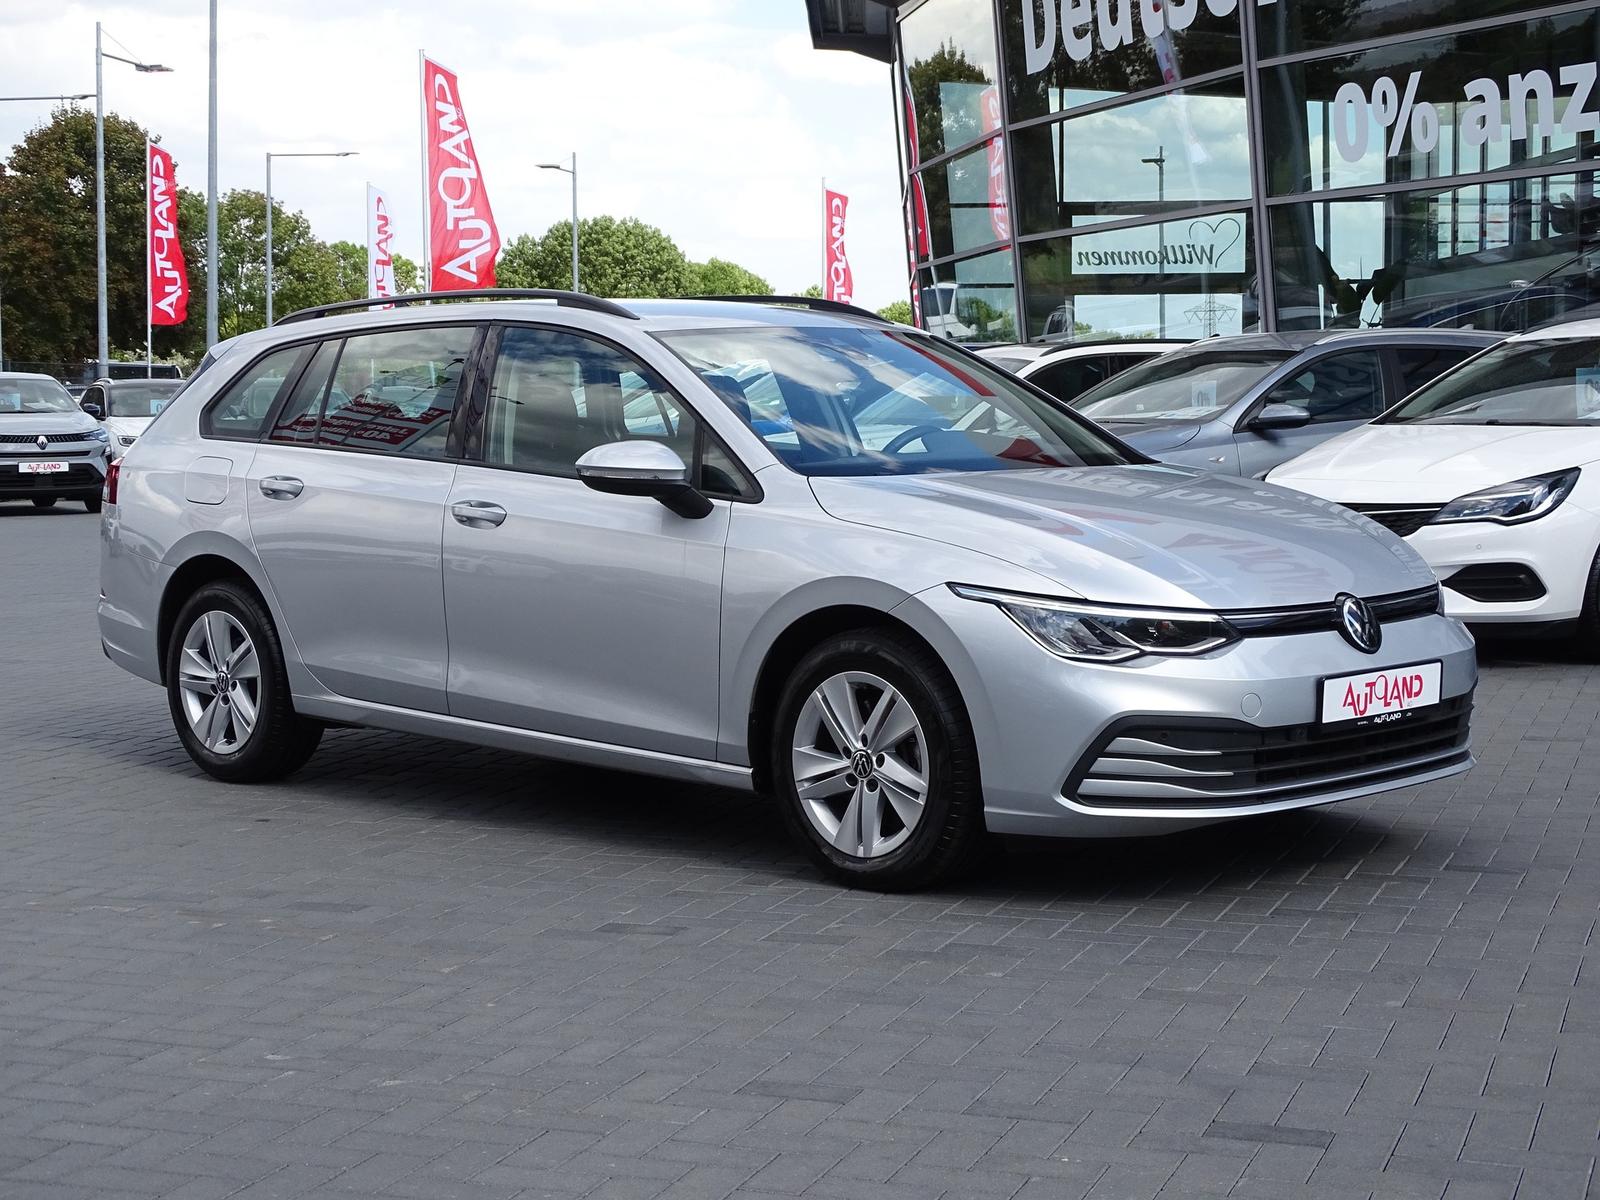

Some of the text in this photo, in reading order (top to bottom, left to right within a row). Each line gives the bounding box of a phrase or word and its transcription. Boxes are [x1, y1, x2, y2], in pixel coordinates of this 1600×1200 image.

[1022, 0, 1237, 75] Deu
[1334, 71, 1439, 163] 0%
[434, 73, 492, 283] AUTOLAND
[152, 155, 182, 319] AUTOLAND
[374, 196, 396, 309] UTOLAND
[831, 197, 852, 304] TOLAND
[1342, 674, 1423, 717] AUTOLAND
